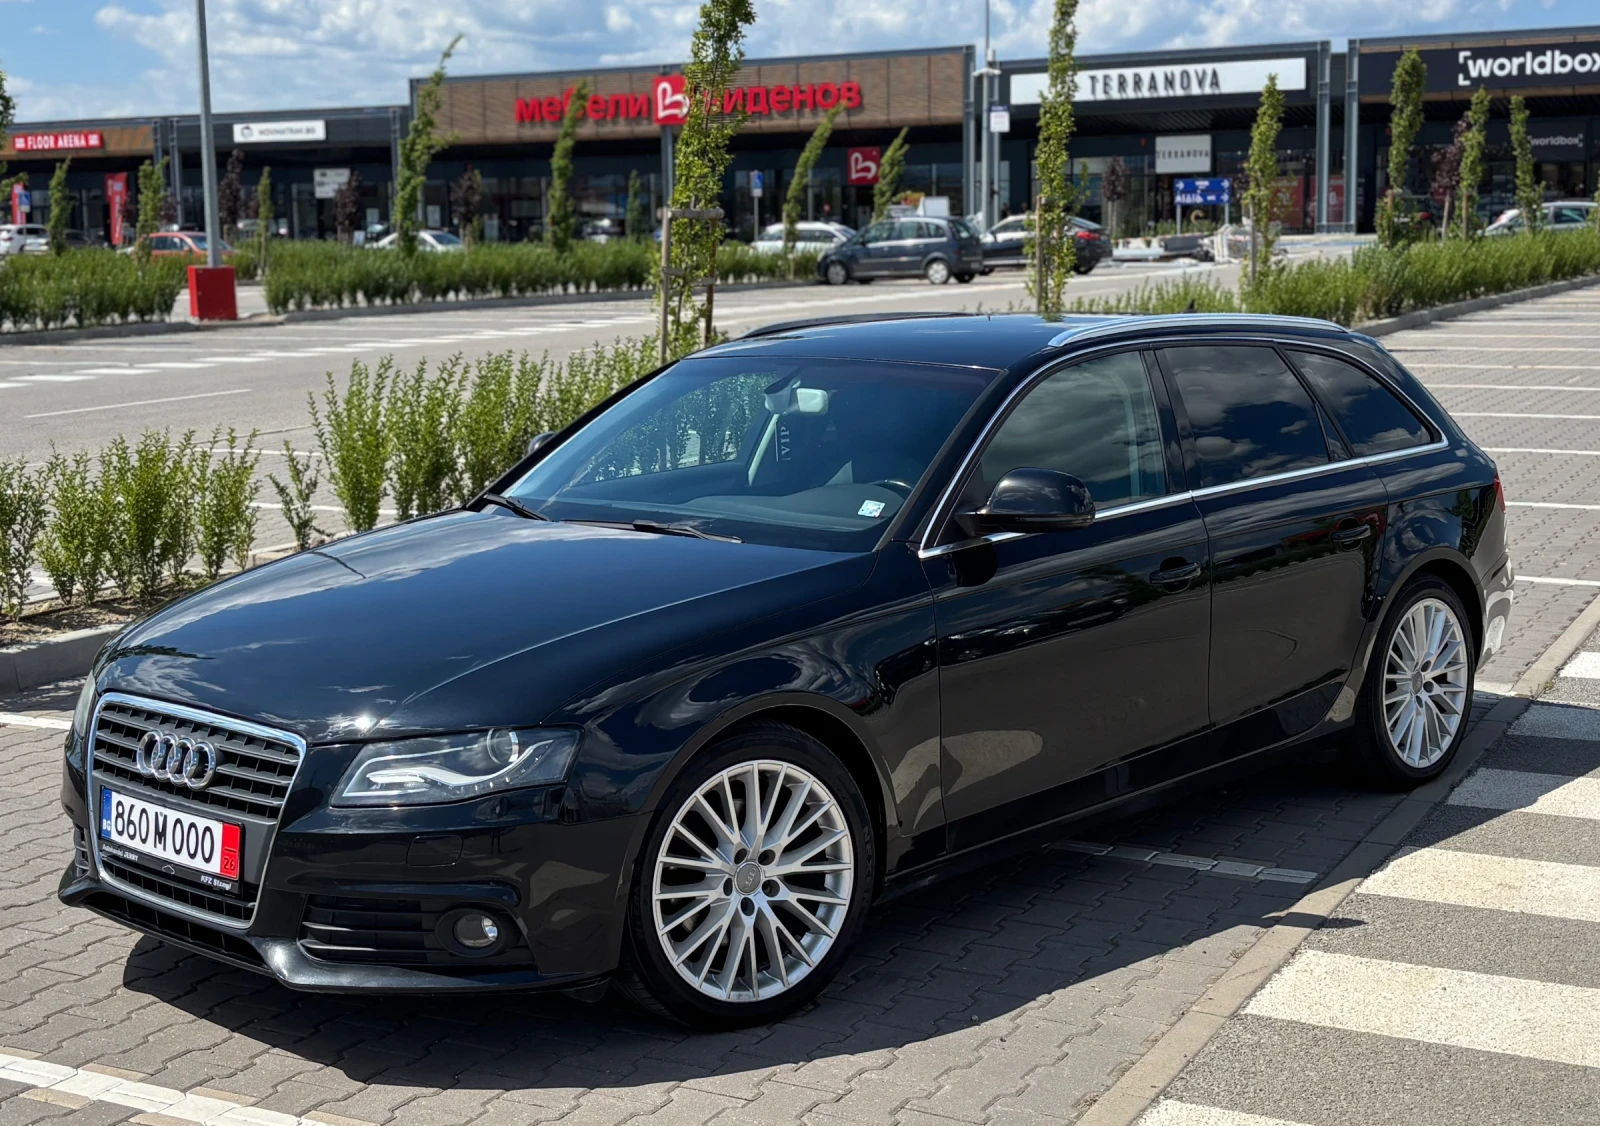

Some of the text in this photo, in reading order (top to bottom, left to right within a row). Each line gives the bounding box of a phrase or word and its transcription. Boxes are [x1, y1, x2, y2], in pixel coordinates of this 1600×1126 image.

[1088, 67, 1221, 96] TERRANOVA
[27, 135, 55, 150] FLOOR
[57, 133, 87, 149] ARENA
[1531, 136, 1579, 147] worldbox
[1156, 149, 1210, 159] TERRANOVA
[780, 426, 790, 455] VIP
[102, 818, 111, 832] BG
[115, 800, 149, 844] 860
[172, 818, 214, 863] 000
[223, 856, 236, 871] 26
